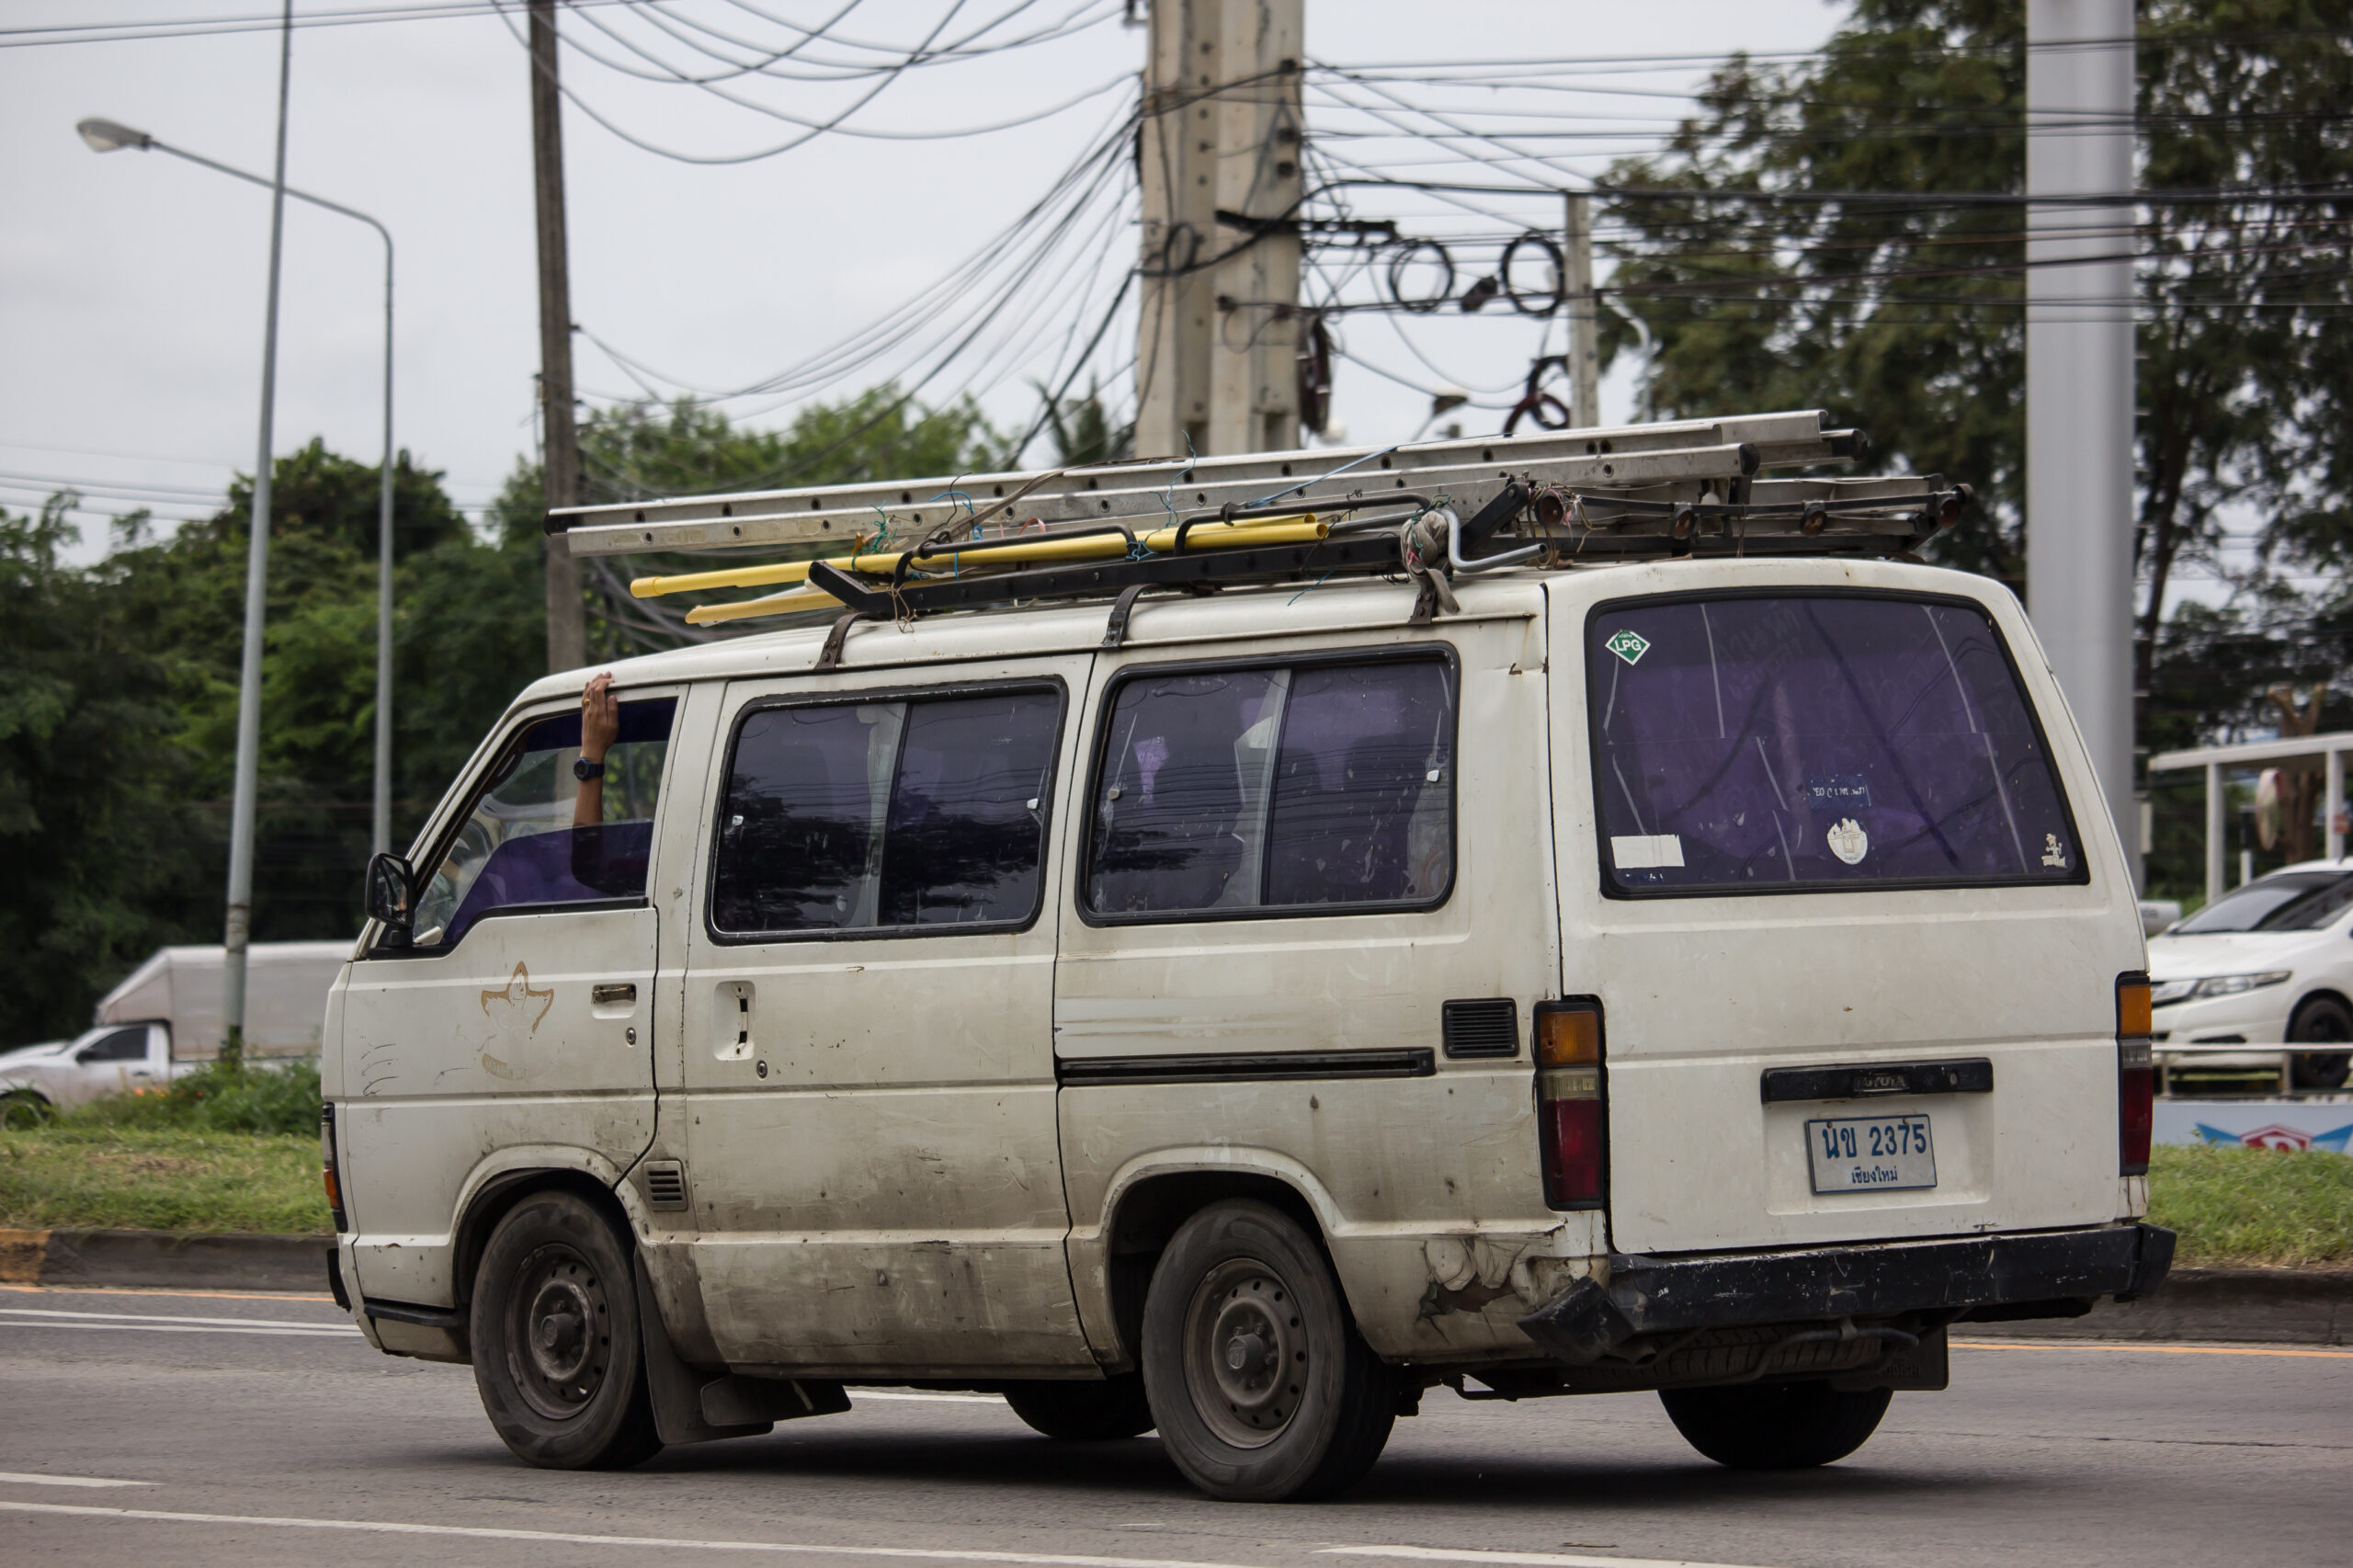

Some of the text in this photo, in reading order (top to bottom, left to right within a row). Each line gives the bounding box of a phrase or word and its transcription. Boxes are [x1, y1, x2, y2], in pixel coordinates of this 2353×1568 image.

[1614, 639, 1642, 652] LPG
[1869, 1123, 1927, 1156] 2375
[1851, 1165, 1898, 1184] เชียงใหม่
